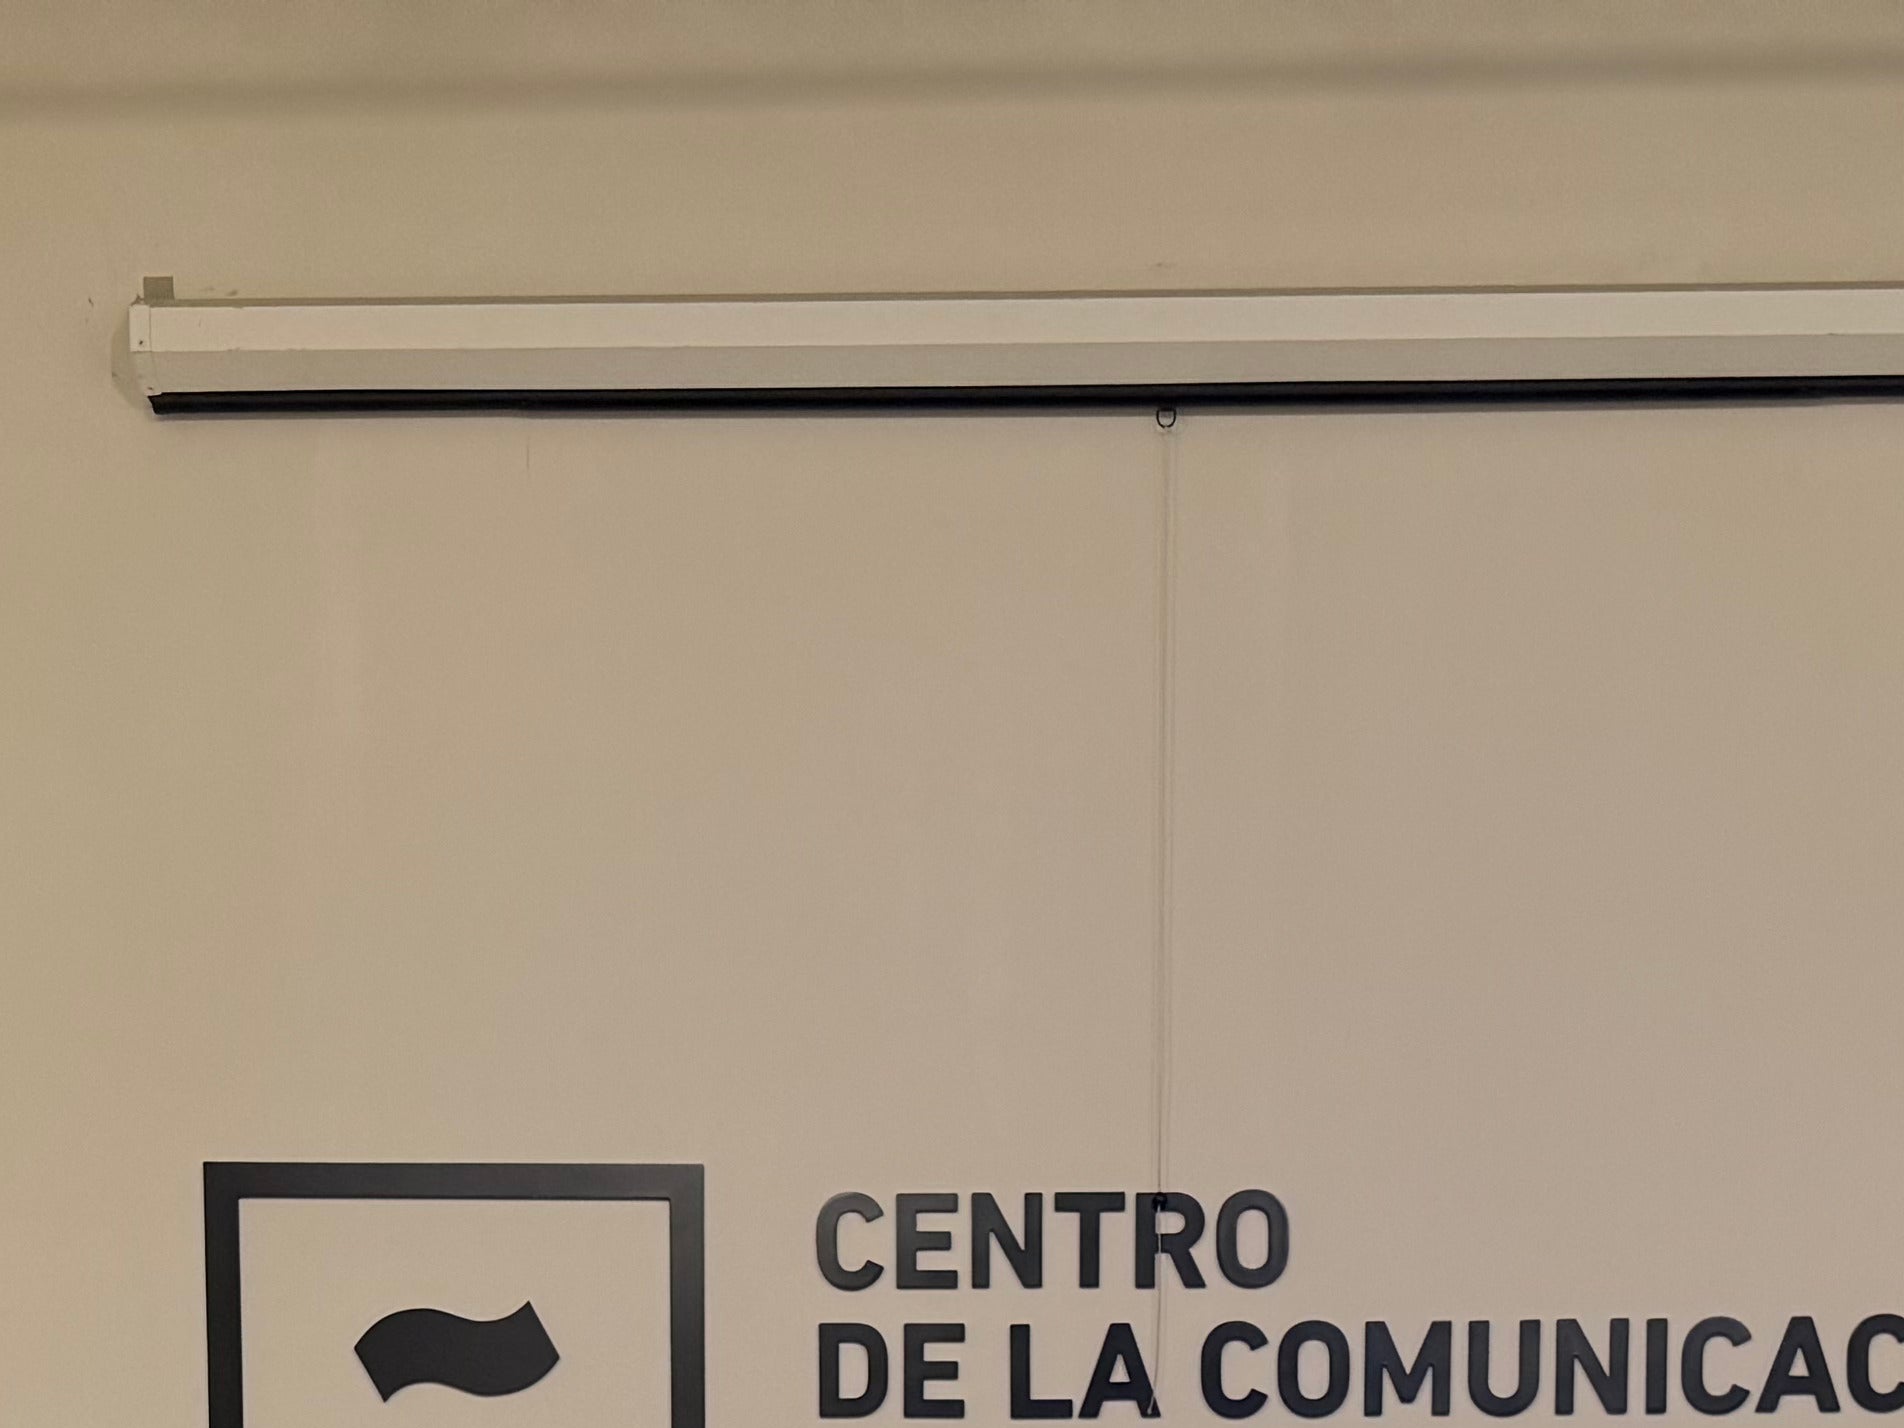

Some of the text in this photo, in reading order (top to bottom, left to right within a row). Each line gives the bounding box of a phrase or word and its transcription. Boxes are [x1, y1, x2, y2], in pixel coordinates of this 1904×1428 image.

[815, 1188, 1291, 1291] CENTRO
[817, 1321, 966, 1420] DE
[1008, 1321, 1162, 1420] LA
